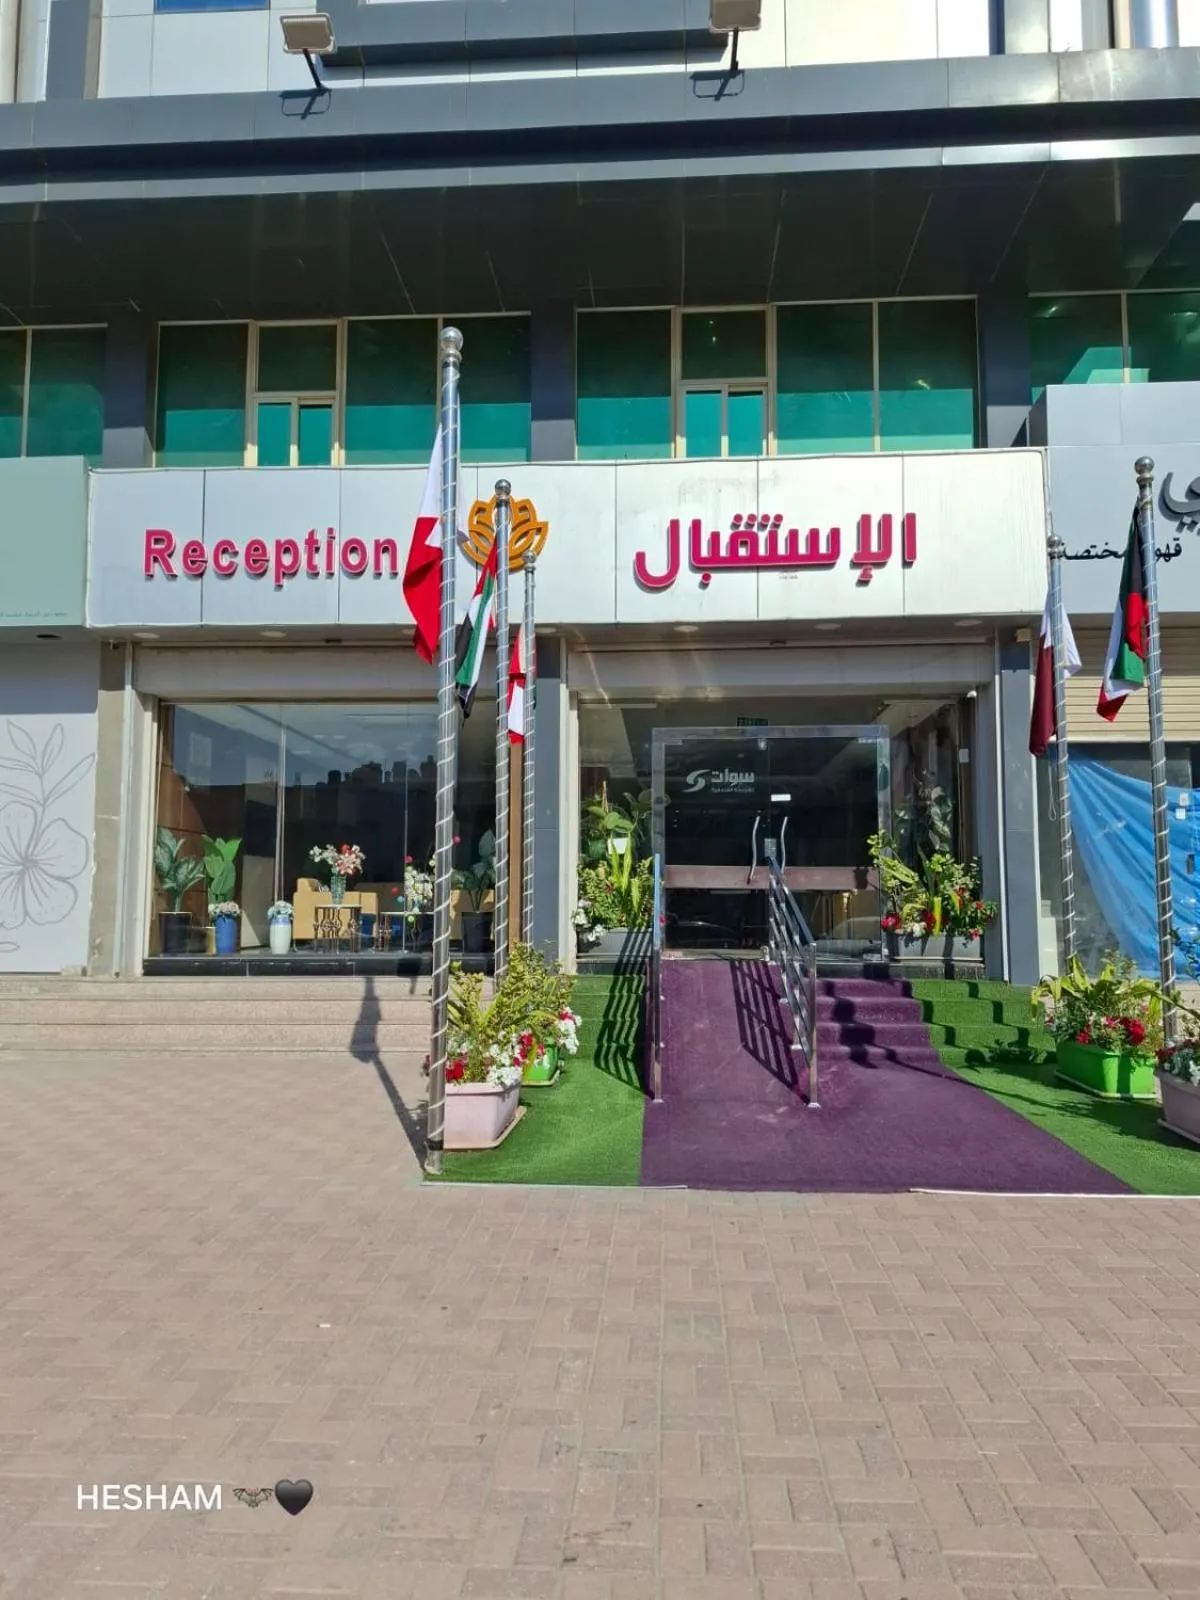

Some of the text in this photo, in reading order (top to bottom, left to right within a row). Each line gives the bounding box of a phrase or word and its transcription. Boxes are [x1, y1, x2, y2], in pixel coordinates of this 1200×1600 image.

[143, 527, 399, 588] Reception
[634, 512, 917, 590] الإستقبال
[1154, 537, 1183, 562] قهو
